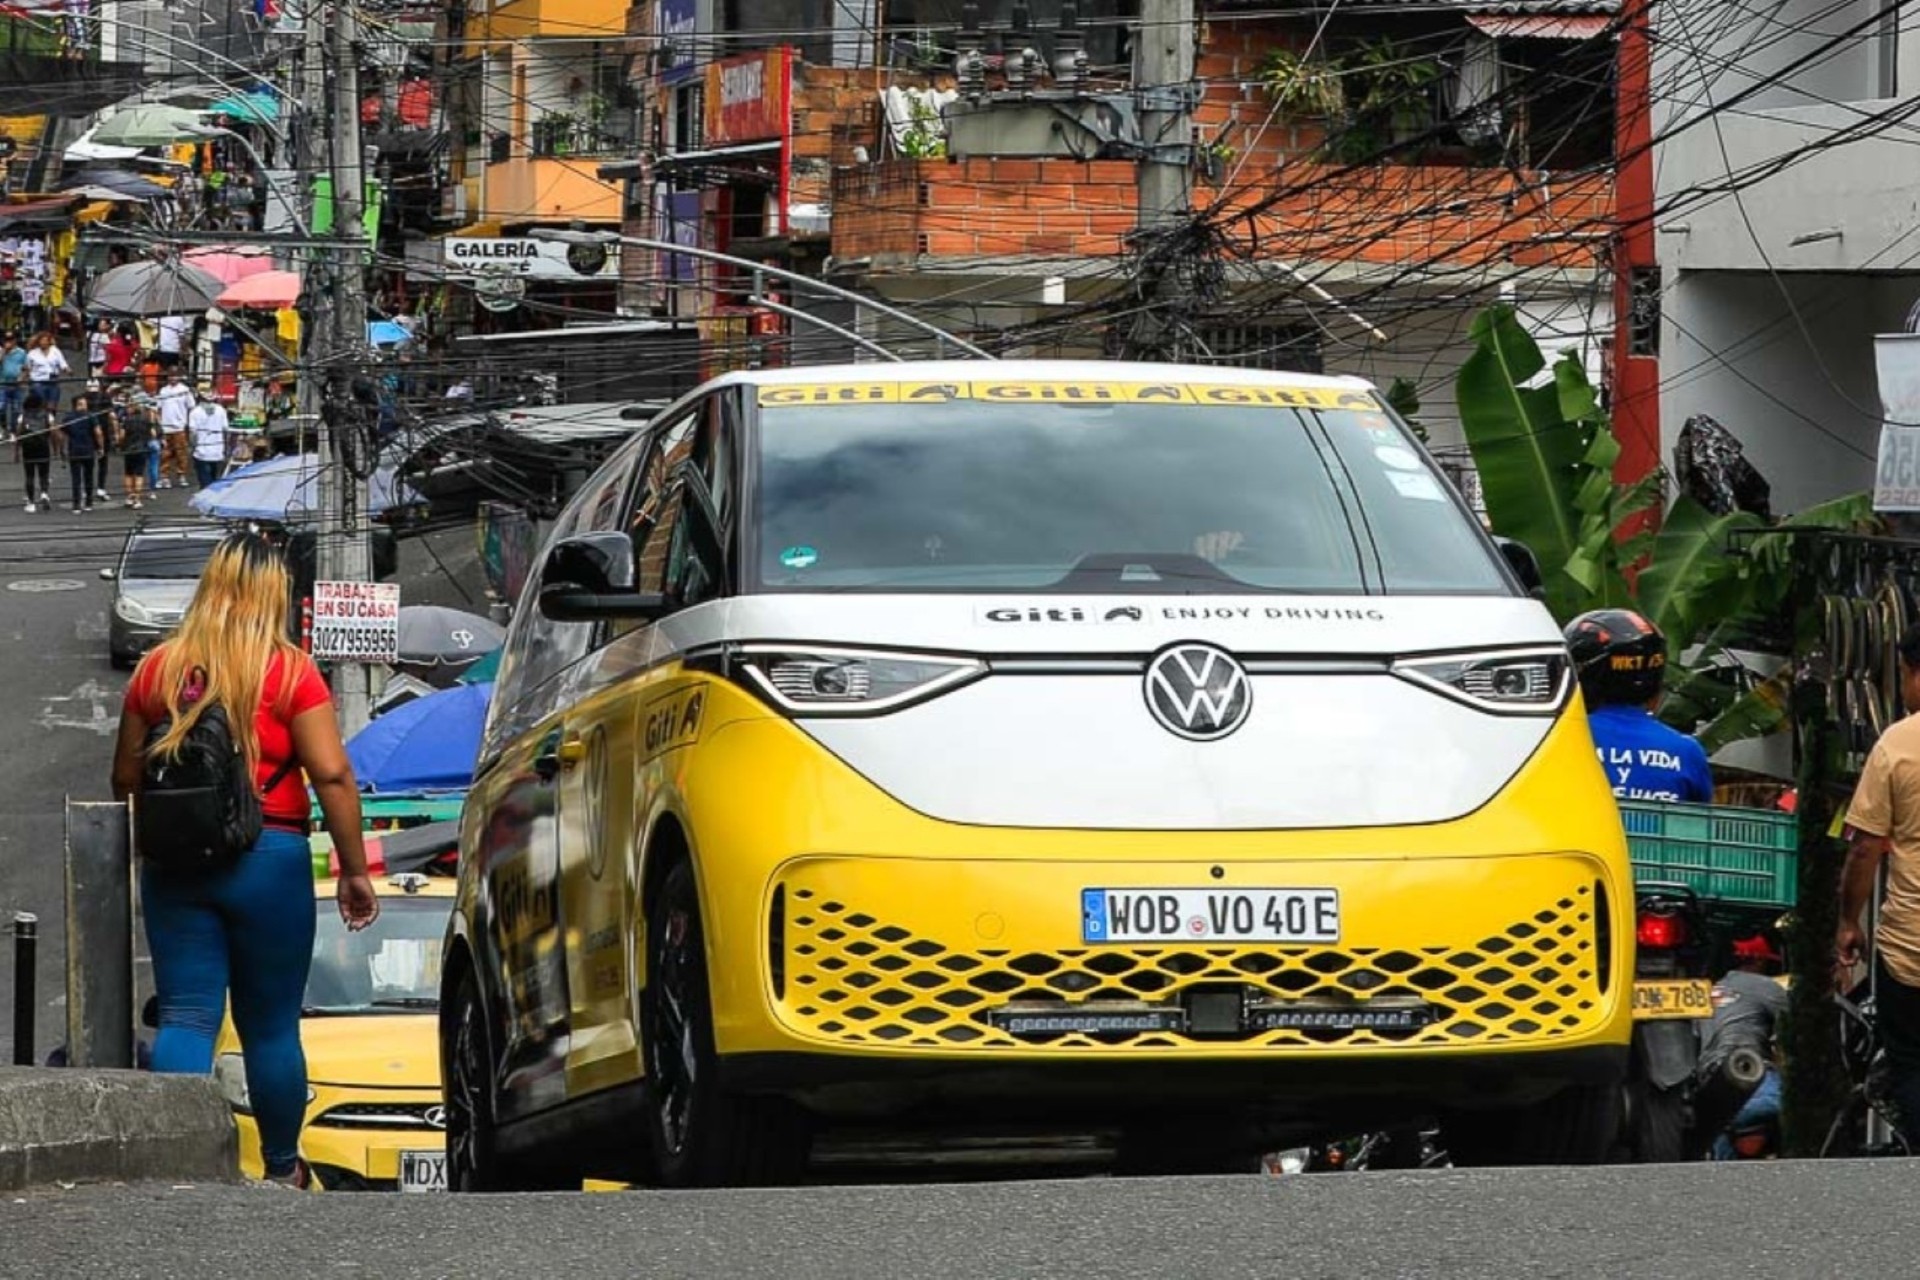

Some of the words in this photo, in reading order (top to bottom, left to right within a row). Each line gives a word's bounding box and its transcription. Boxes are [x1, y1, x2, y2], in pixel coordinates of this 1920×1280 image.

[453, 240, 539, 258] GALERÍA
[760, 387, 884, 402] Giti
[986, 386, 1111, 398] Giti
[1206, 388, 1321, 405] Giti
[316, 583, 376, 600] TRABAJE
[316, 601, 334, 617] EN
[337, 601, 355, 617] SU
[357, 601, 396, 618] CASA
[986, 606, 1084, 622] Giti
[1162, 606, 1252, 620] ENJOY
[1264, 606, 1385, 621] DRIVING
[313, 627, 396, 653] 3027955956
[645, 704, 678, 752] Giti
[1610, 747, 1633, 765] LA
[1638, 749, 1681, 772] VIDA
[1616, 767, 1632, 784] Y
[1108, 894, 1181, 935] WOB
[1208, 894, 1254, 935] VO
[1263, 894, 1338, 935] 40E
